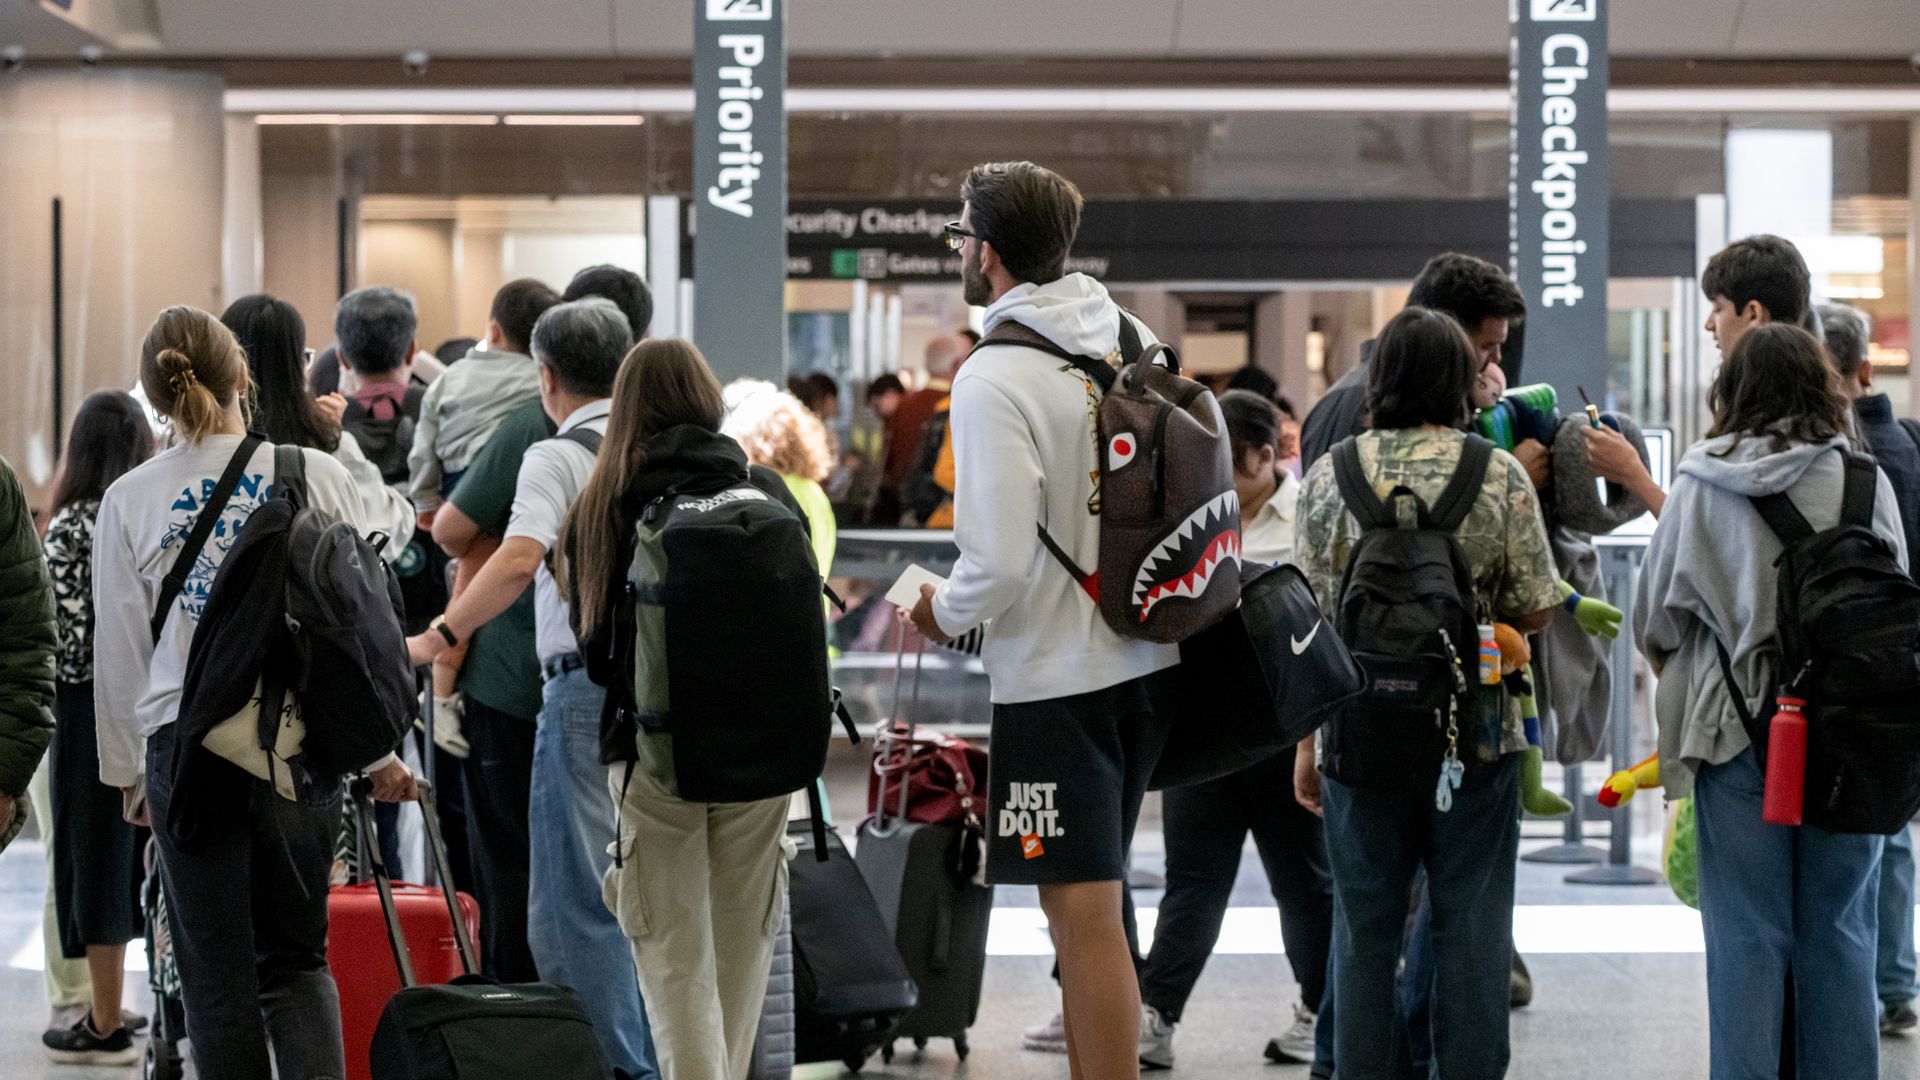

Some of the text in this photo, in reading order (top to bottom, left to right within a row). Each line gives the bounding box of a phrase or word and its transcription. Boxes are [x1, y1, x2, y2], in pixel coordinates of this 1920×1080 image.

[708, 34, 764, 218] Priority
[1531, 33, 1589, 307] Checkpoint
[785, 208, 858, 238] curity
[1006, 782, 1057, 810] JUST
[999, 810, 1065, 837] DO IT.
